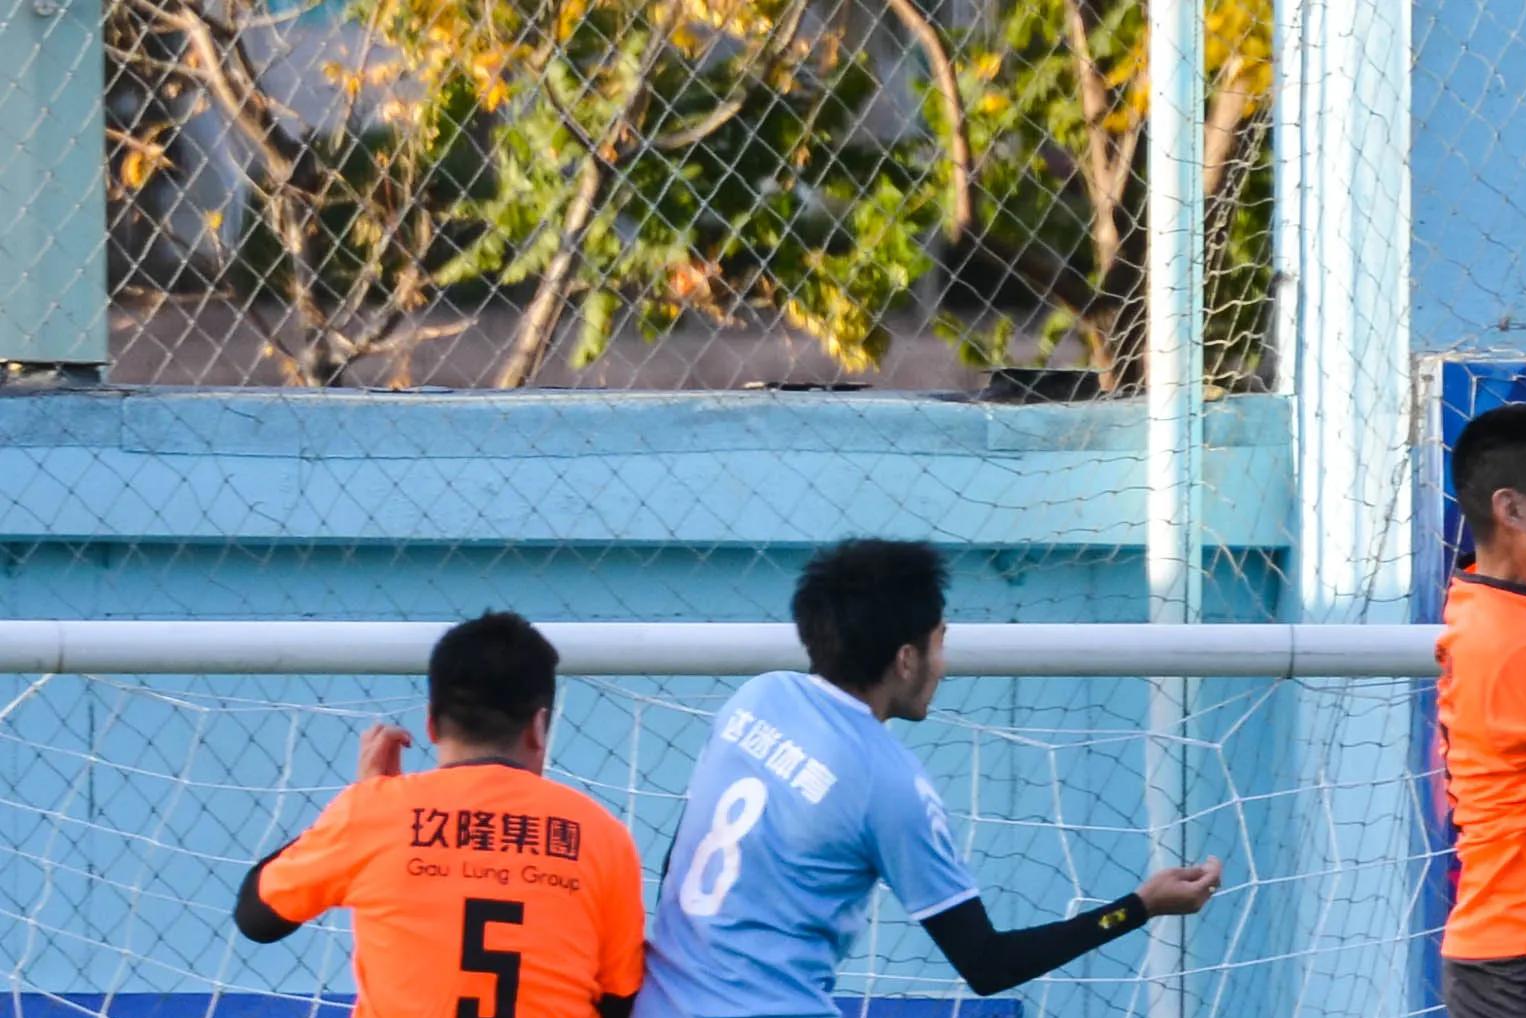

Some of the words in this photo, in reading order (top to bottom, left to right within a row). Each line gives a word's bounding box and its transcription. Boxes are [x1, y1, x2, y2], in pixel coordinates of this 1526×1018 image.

[407, 857, 449, 877] Gau
[462, 861, 509, 885] Lung
[521, 864, 580, 892] Group
[679, 777, 769, 917] 8
